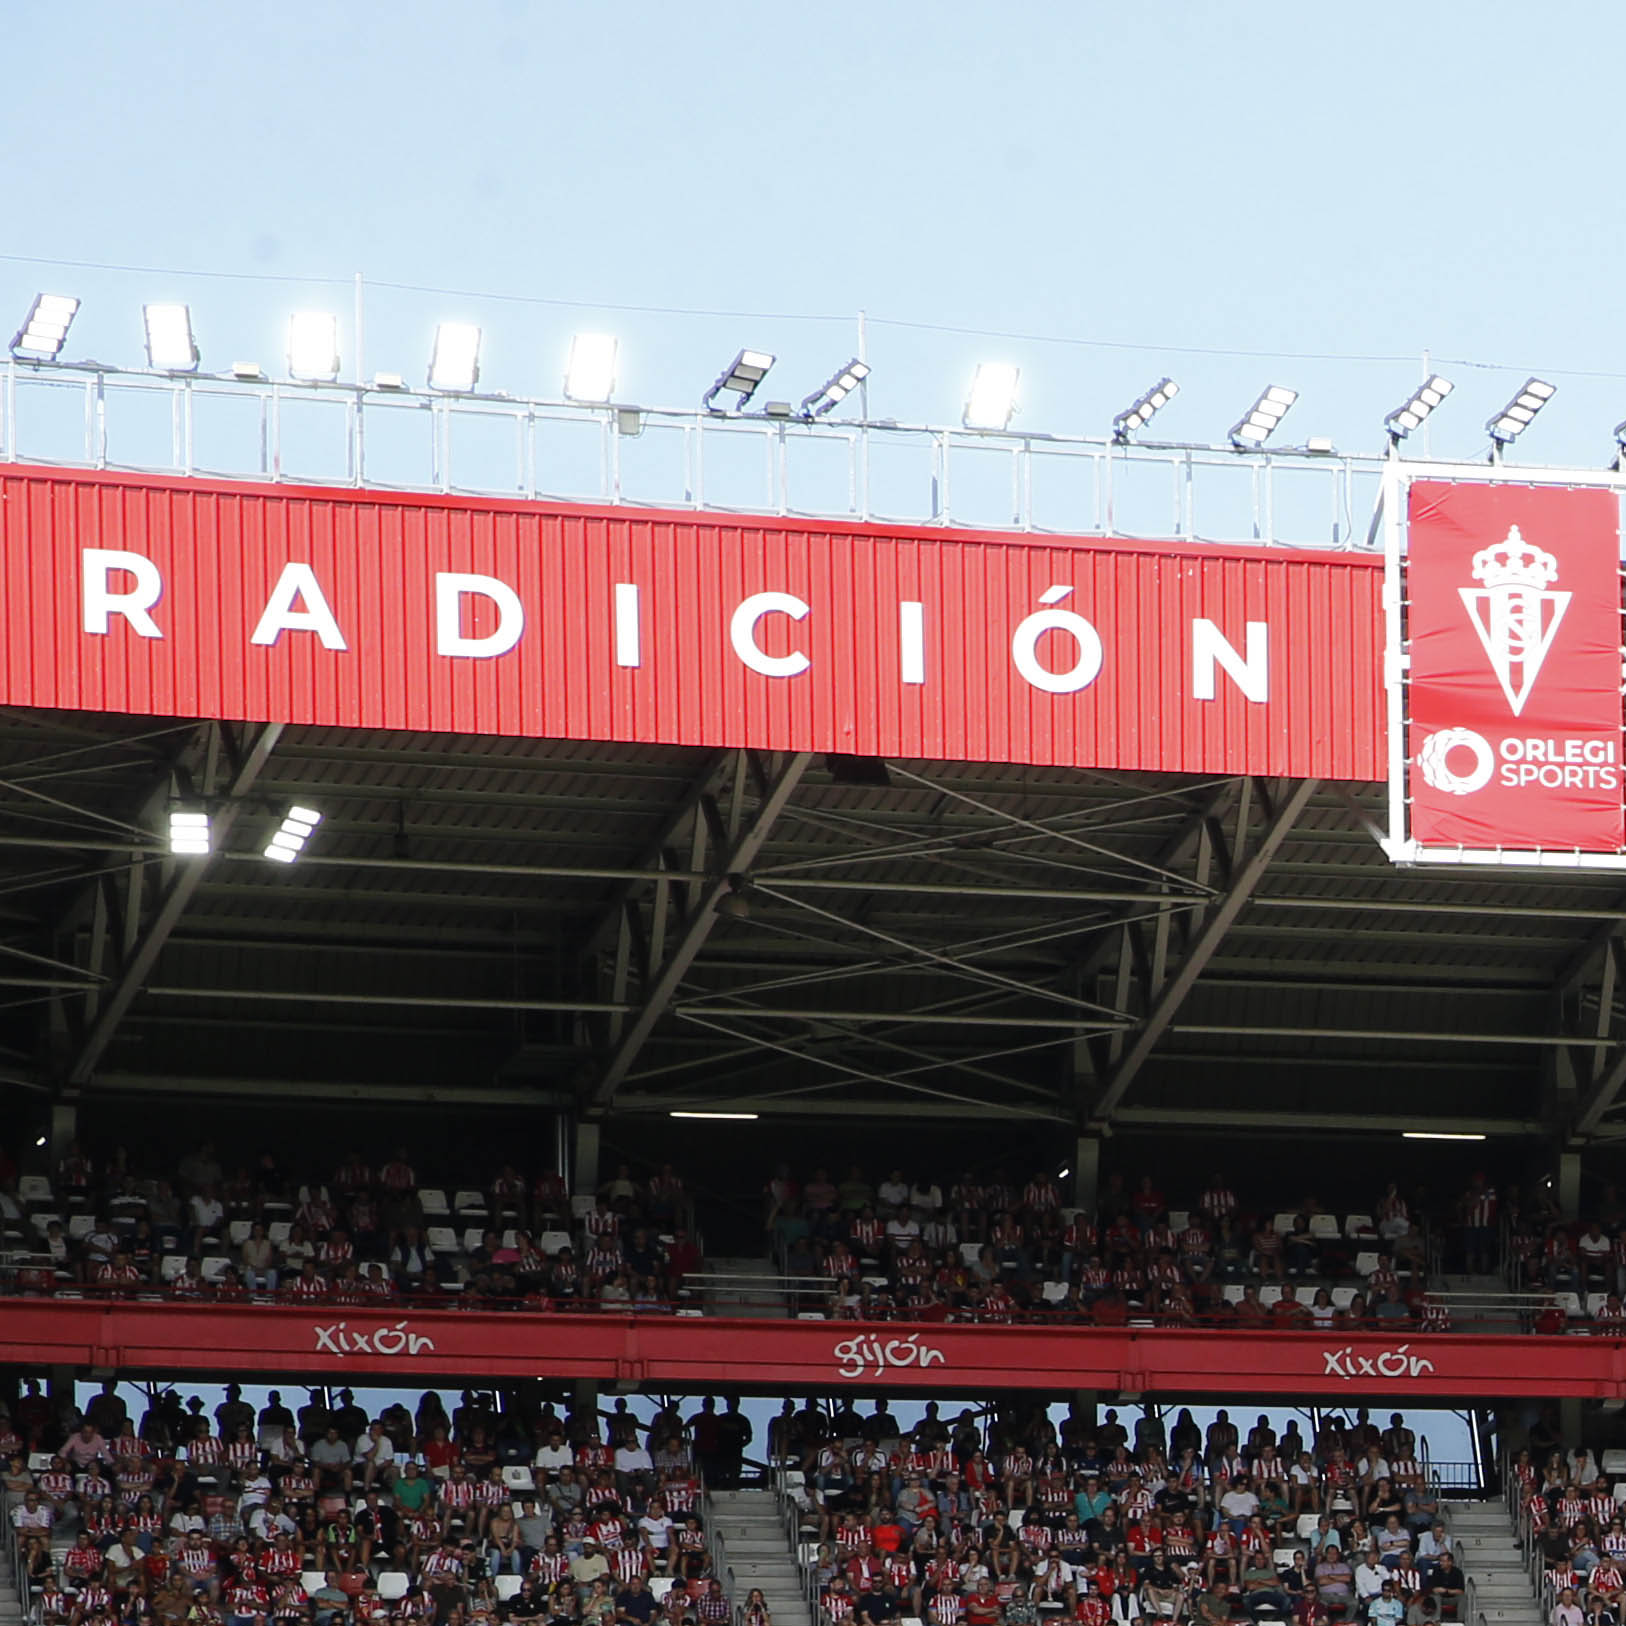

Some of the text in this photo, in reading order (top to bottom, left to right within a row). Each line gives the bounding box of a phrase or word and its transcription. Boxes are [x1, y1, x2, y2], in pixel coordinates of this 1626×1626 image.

[83, 542, 1273, 702] RADICIÓN
[1499, 737, 1616, 764] ORLEGI
[1500, 760, 1617, 791] SPORTS
